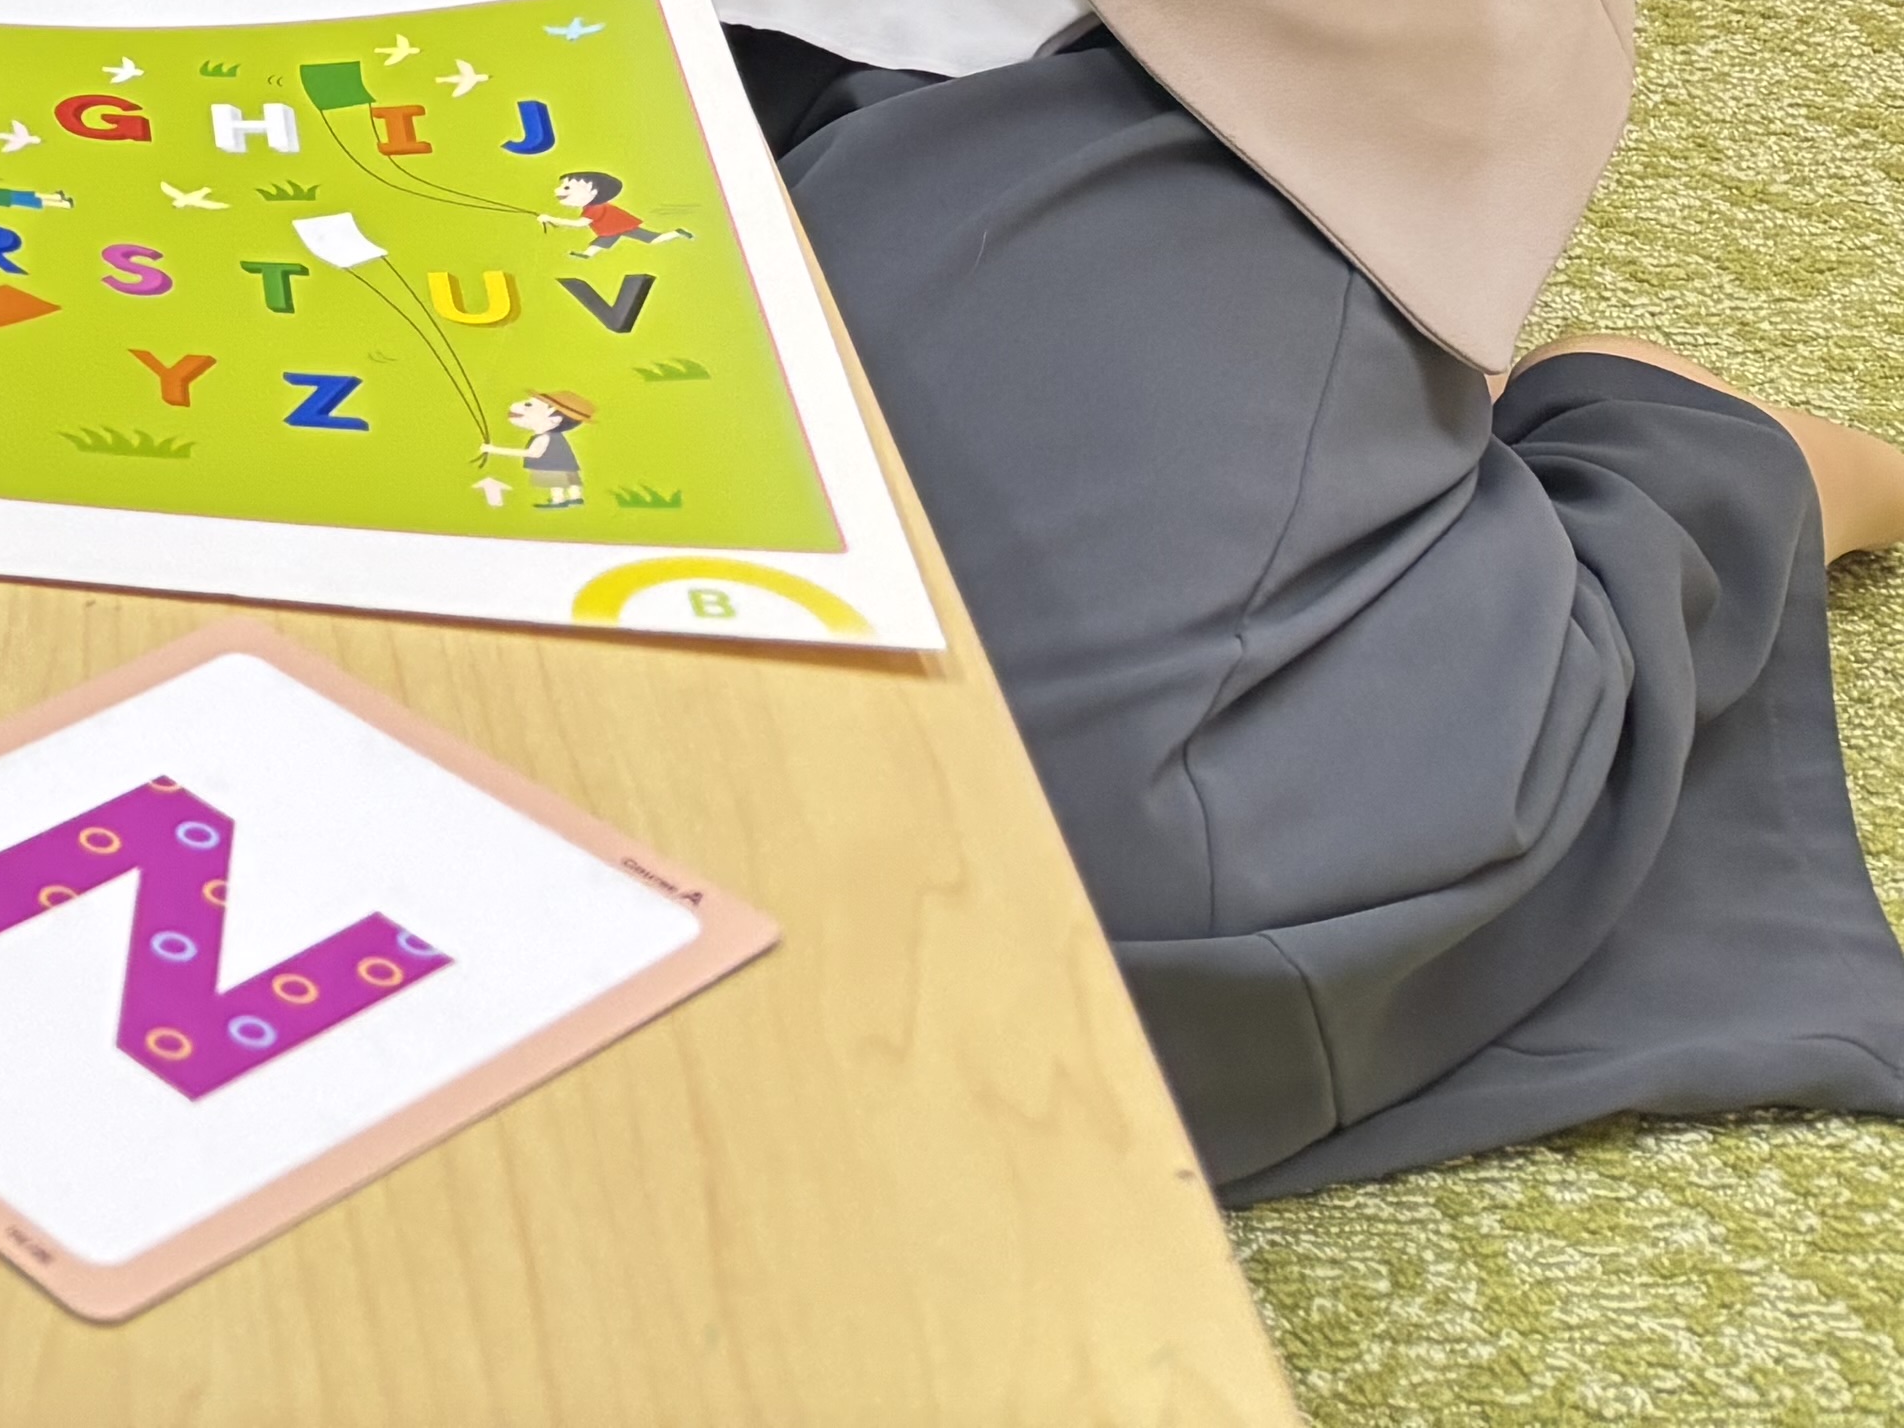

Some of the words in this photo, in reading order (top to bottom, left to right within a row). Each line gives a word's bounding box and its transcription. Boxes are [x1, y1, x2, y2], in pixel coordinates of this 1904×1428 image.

[54, 94, 153, 142] G
[210, 103, 300, 154] H
[373, 105, 433, 156] I
[500, 100, 556, 155] J
[101, 244, 173, 296] S
[240, 260, 310, 314] T
[427, 270, 522, 327] U
[555, 273, 657, 333] V
[128, 348, 217, 407] Y
[283, 371, 370, 431] Z
[687, 588, 737, 619] B
[680, 891, 704, 909] A
